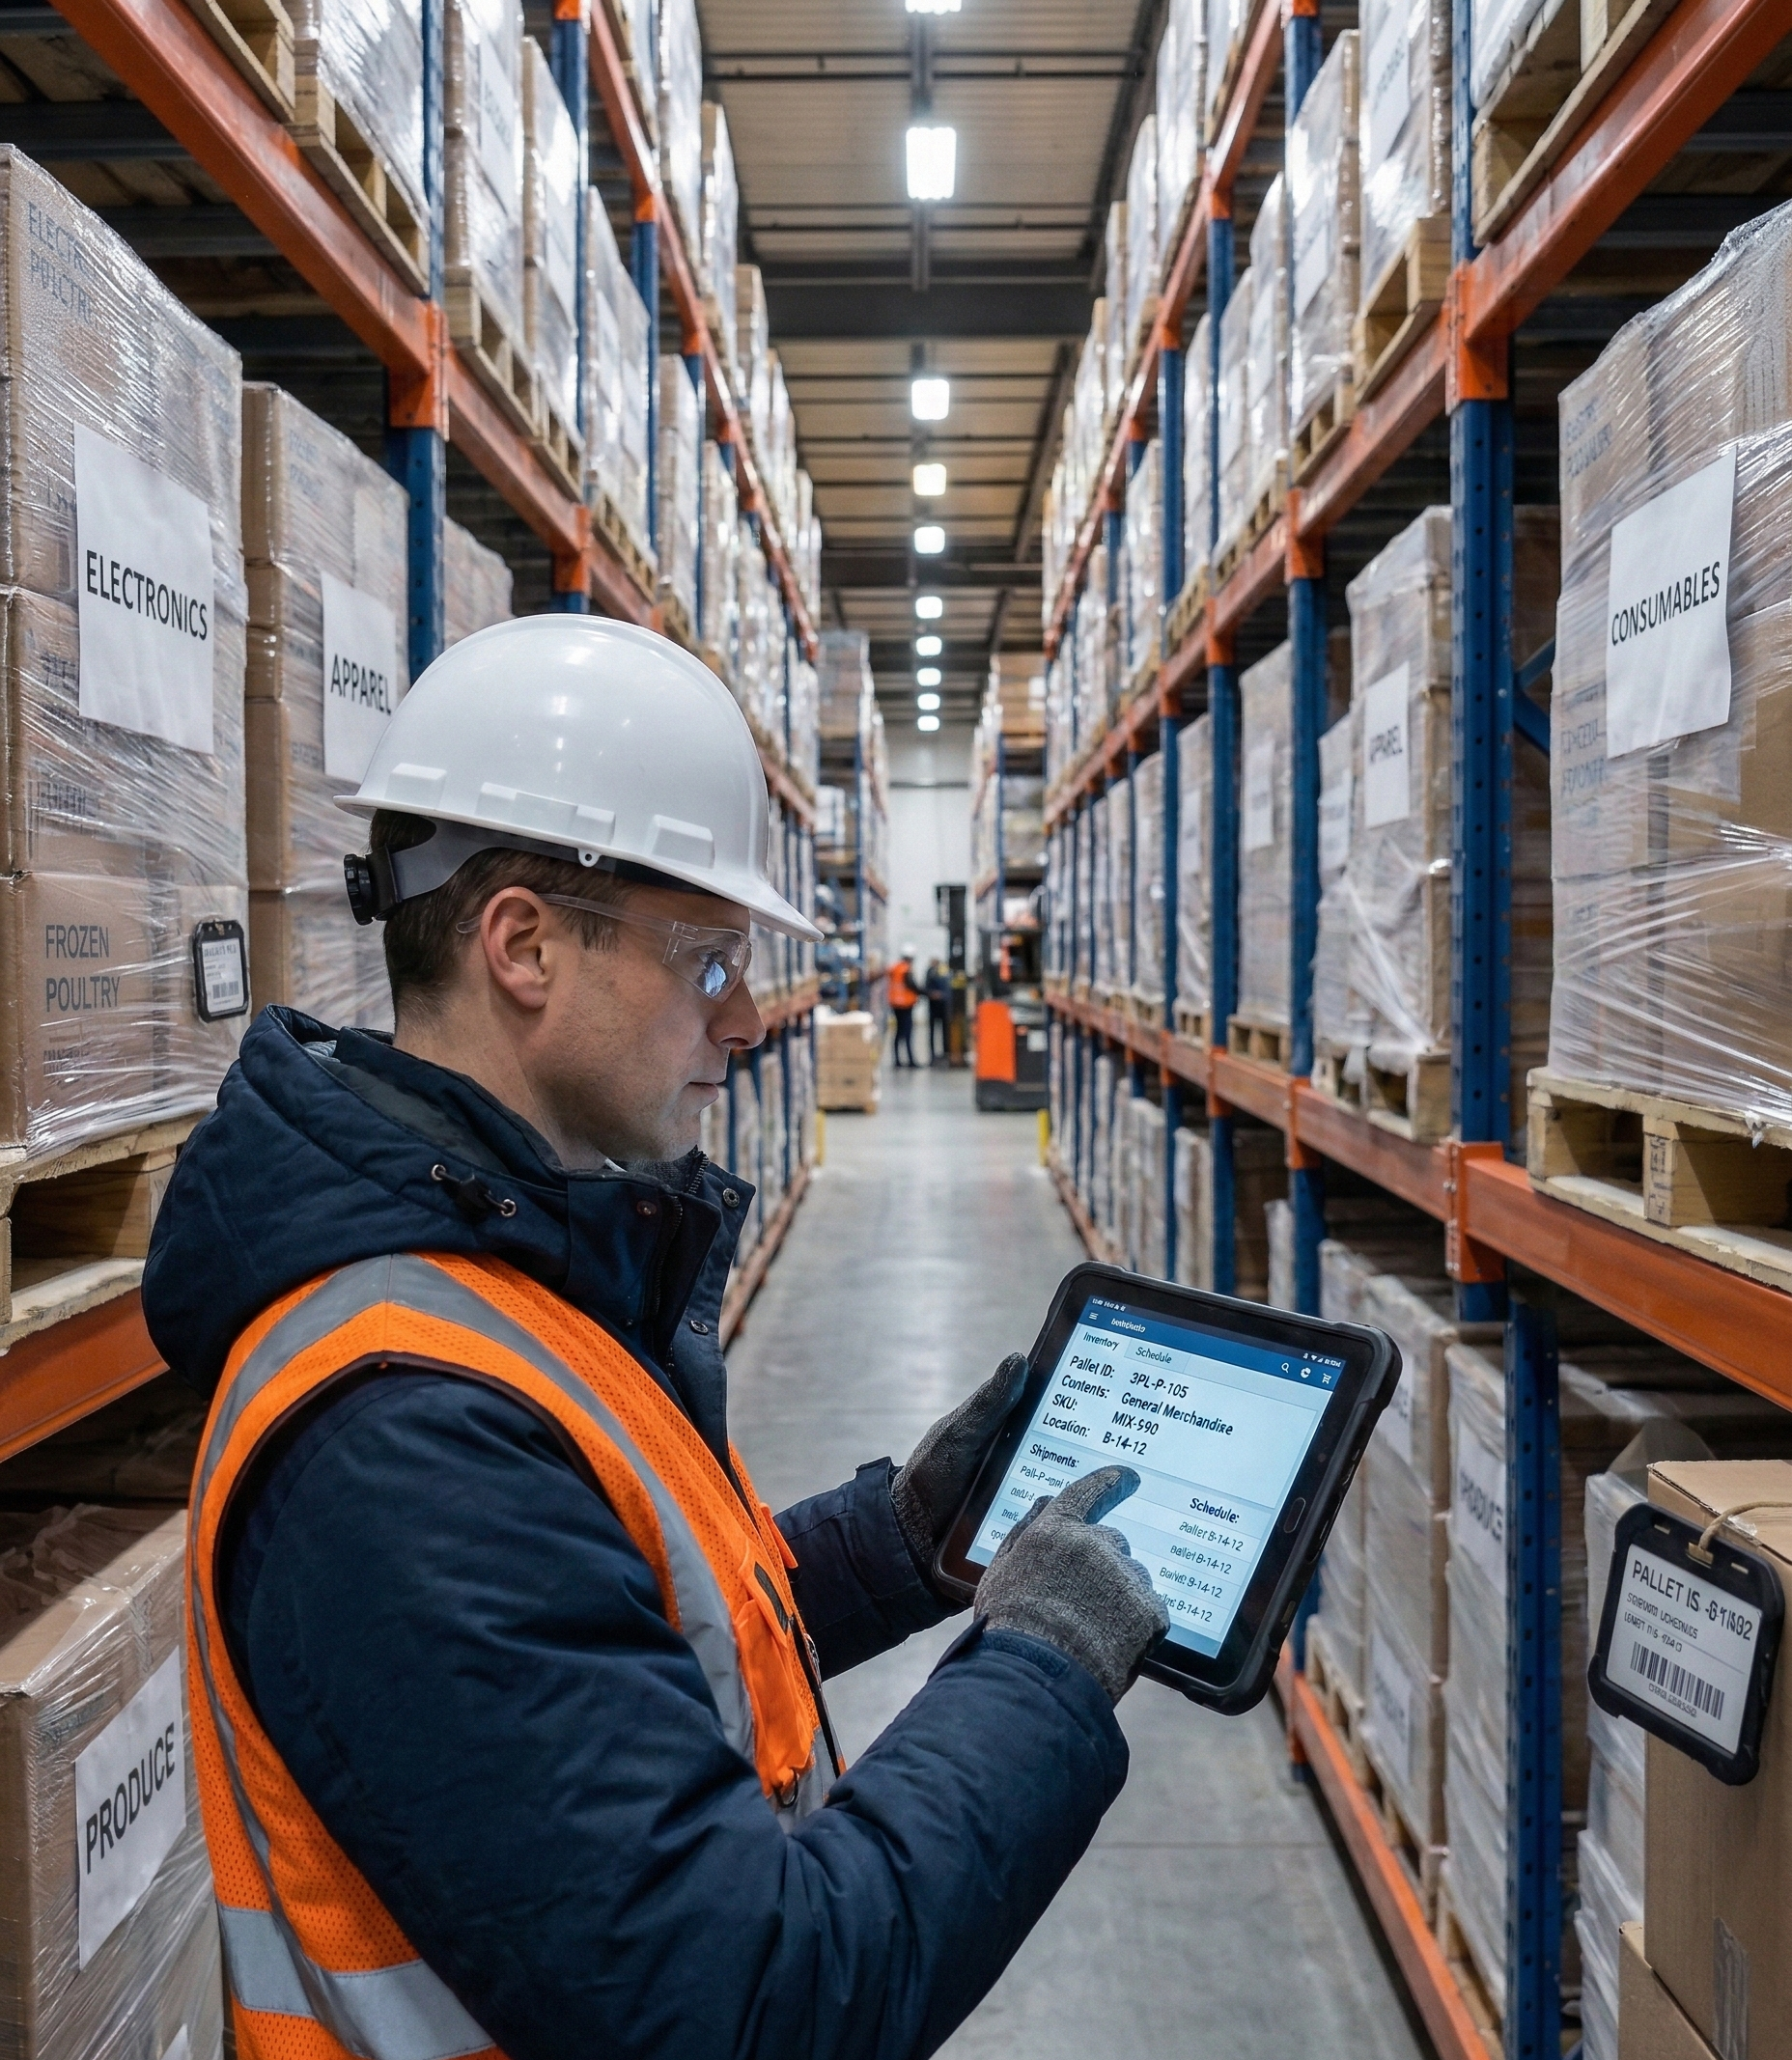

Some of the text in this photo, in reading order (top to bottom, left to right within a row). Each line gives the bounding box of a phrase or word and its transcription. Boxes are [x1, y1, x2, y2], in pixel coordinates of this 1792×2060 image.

[87, 549, 208, 641] ELECTRONICS
[1611, 561, 1721, 647] CONSUMABLES
[330, 654, 391, 716] APPAREL
[45, 924, 109, 959] FROZEN
[46, 975, 120, 1013] POULTRY
[1083, 1331, 1119, 1351] Inventory
[1135, 1347, 1172, 1364] Schedule
[1061, 1375, 1110, 1399] Contents:
[1121, 1392, 1163, 1415] General
[1069, 1355, 1190, 1399] Pallet ID: 3PL-P-105
[1051, 1394, 1078, 1411] SKU:
[1042, 1412, 1148, 1456] Location: B-14-12
[1029, 1443, 1079, 1468] Shipments:
[1190, 1497, 1240, 1523] Schedule:
[1632, 1560, 1684, 1602] PALLET
[86, 1721, 175, 1876] PRODUCE
